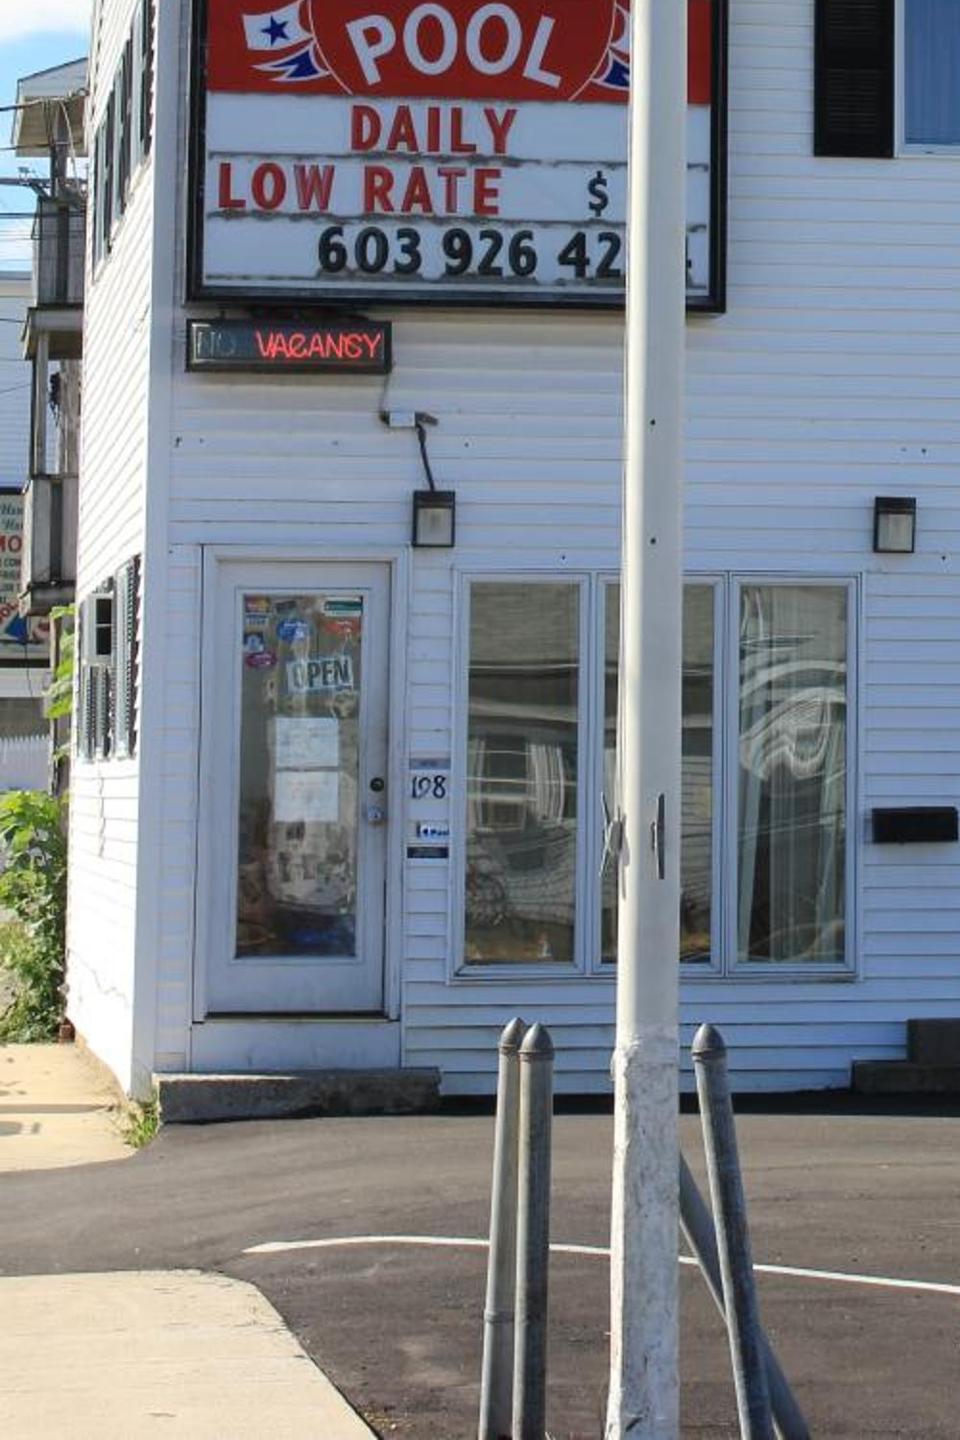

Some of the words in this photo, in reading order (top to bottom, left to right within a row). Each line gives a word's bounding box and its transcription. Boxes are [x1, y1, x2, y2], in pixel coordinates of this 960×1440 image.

[345, 2, 563, 88] POOL
[350, 105, 518, 154] DAILY
[217, 163, 336, 212] LOW
[363, 166, 503, 216] RATE
[317, 227, 423, 275] 603
[442, 230, 538, 276] 926
[557, 231, 693, 279] 42
[255, 331, 382, 359] VACANCY
[292, 657, 351, 690] OPEN
